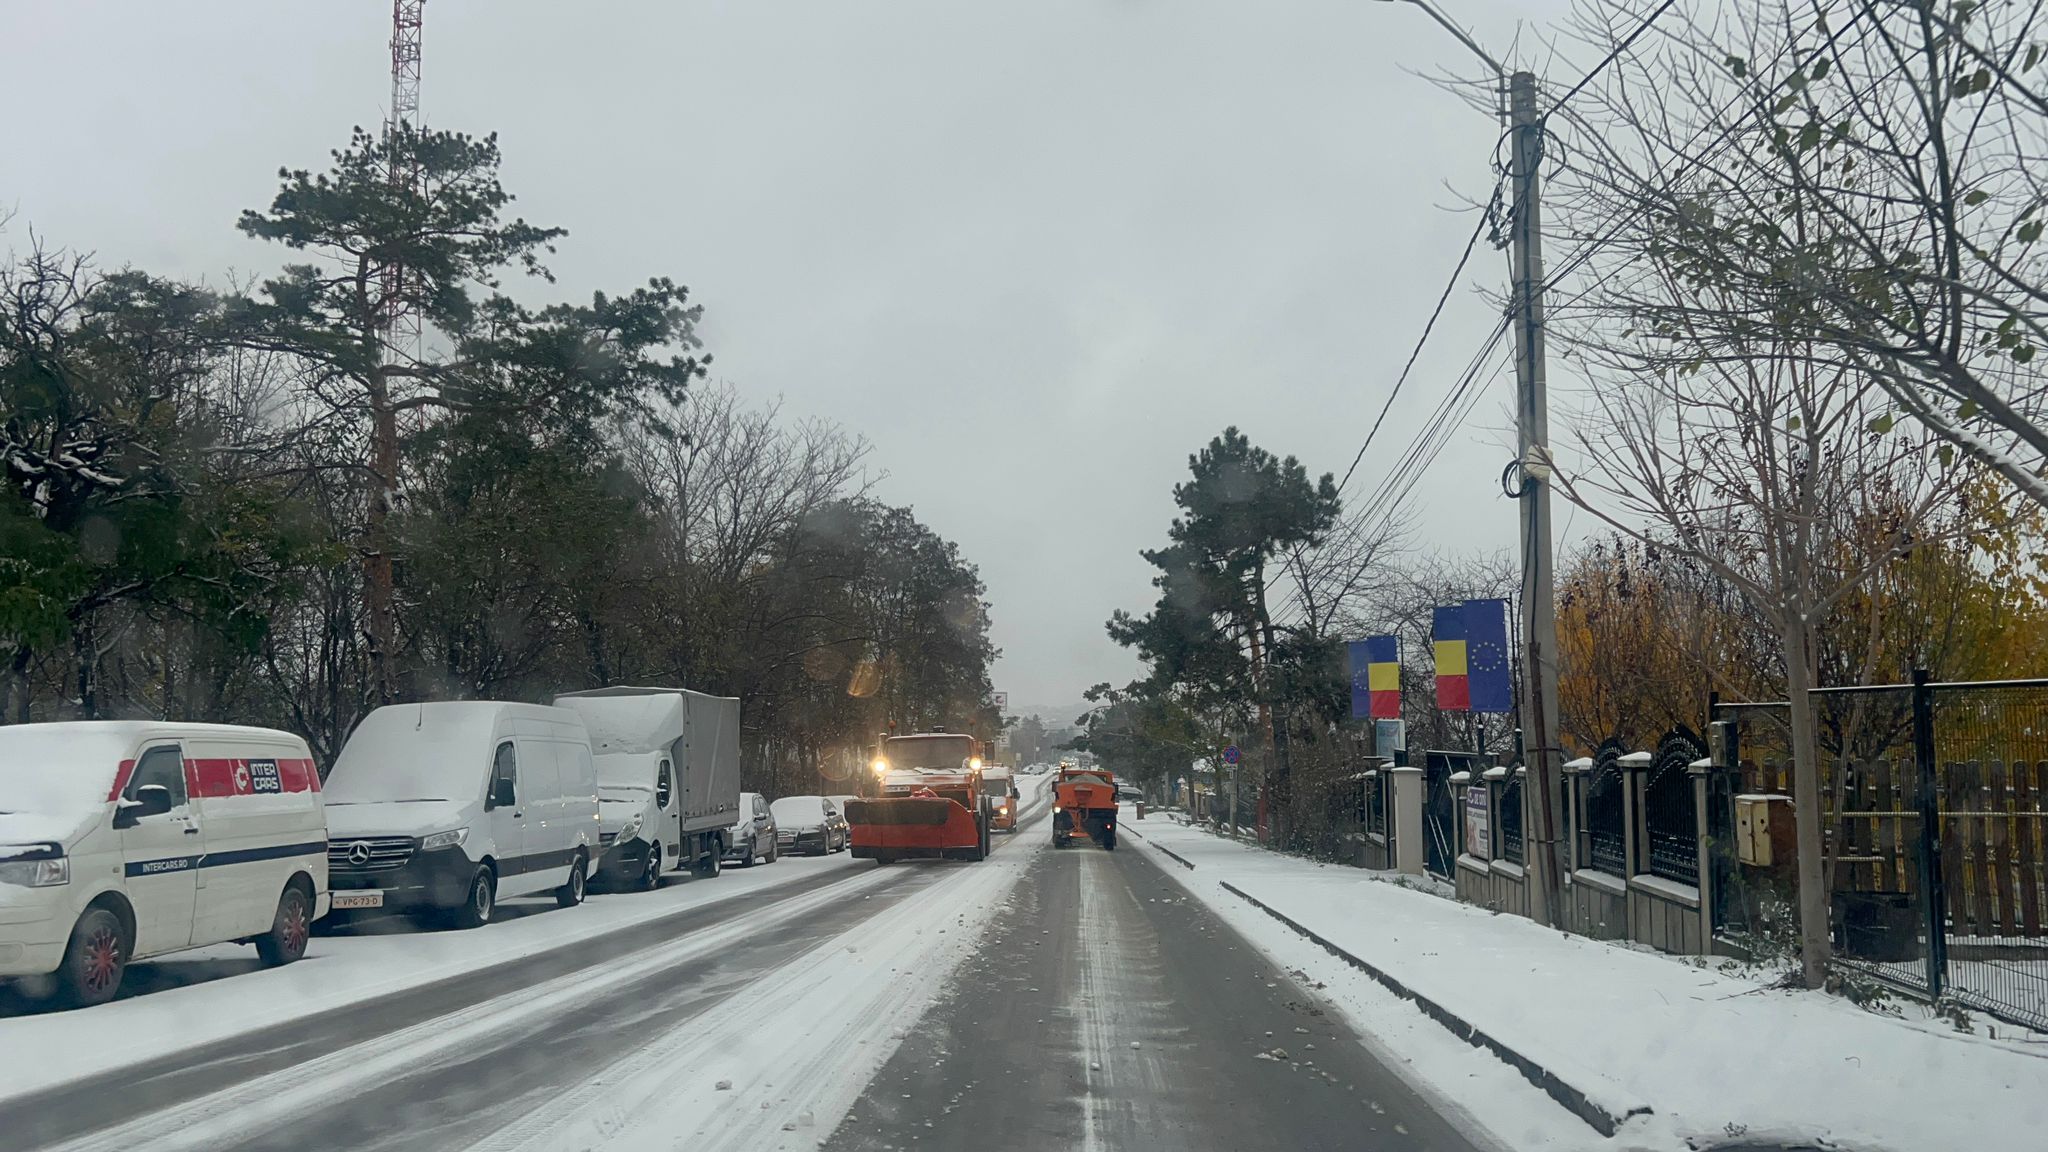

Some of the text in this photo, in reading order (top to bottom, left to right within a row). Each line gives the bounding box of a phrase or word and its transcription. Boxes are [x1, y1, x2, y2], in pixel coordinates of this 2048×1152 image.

[250, 763, 277, 776] INTER
[253, 777, 279, 790] CARS
[142, 860, 188, 873] INTERCARS.RO
